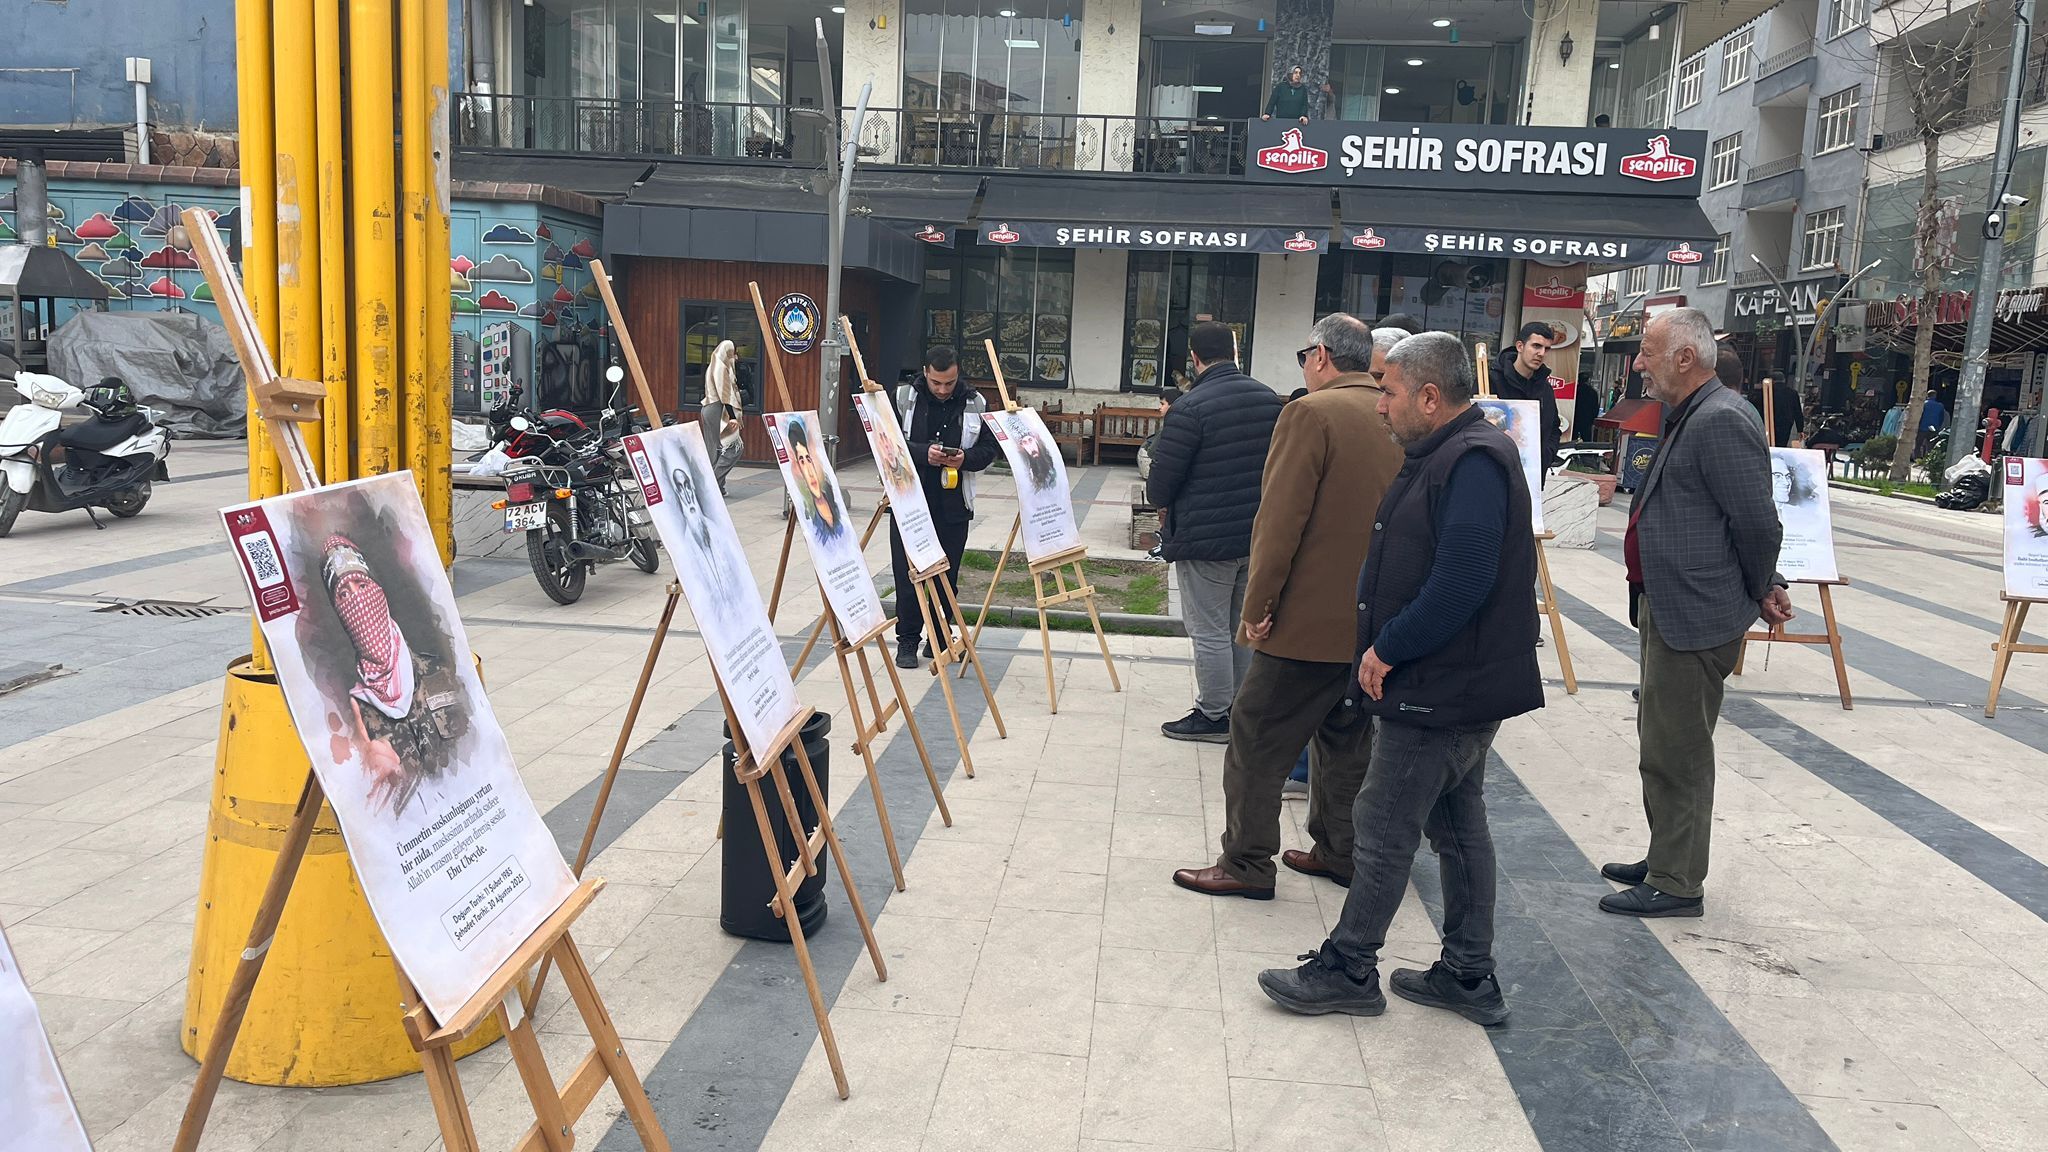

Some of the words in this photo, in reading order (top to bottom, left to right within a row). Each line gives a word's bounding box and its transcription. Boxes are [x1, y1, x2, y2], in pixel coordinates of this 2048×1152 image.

[1265, 151, 1319, 167] şenpiliç
[1340, 128, 1443, 177] ŞEHİR
[1454, 138, 1608, 176] SOFRASI
[1629, 159, 1687, 176] şenpiliç
[1056, 226, 1131, 246] ŞEHİR
[1139, 230, 1247, 247] SOFRASI
[1424, 233, 1504, 252] ŞEHİR
[1512, 238, 1628, 258] SOFRASI
[1734, 284, 1820, 317] KAPLAN
[507, 507, 521, 517] 72
[524, 503, 546, 515] ACV
[514, 517, 536, 528] 364
[396, 827, 432, 856] Ümmetin
[431, 795, 475, 832] suskunluğunu
[473, 783, 492, 803] yırtan
[400, 859, 413, 874] bir
[413, 847, 433, 866] nida,
[445, 864, 462, 880] Ebu
[459, 844, 487, 868] Ubeyde.
[452, 905, 471, 924] Doğum
[468, 892, 486, 908] Tarihi:
[487, 876, 503, 893] Şubat
[454, 919, 475, 941] Şehadet
[472, 905, 489, 922] Tarihi:
[494, 885, 512, 903] Ağustos
